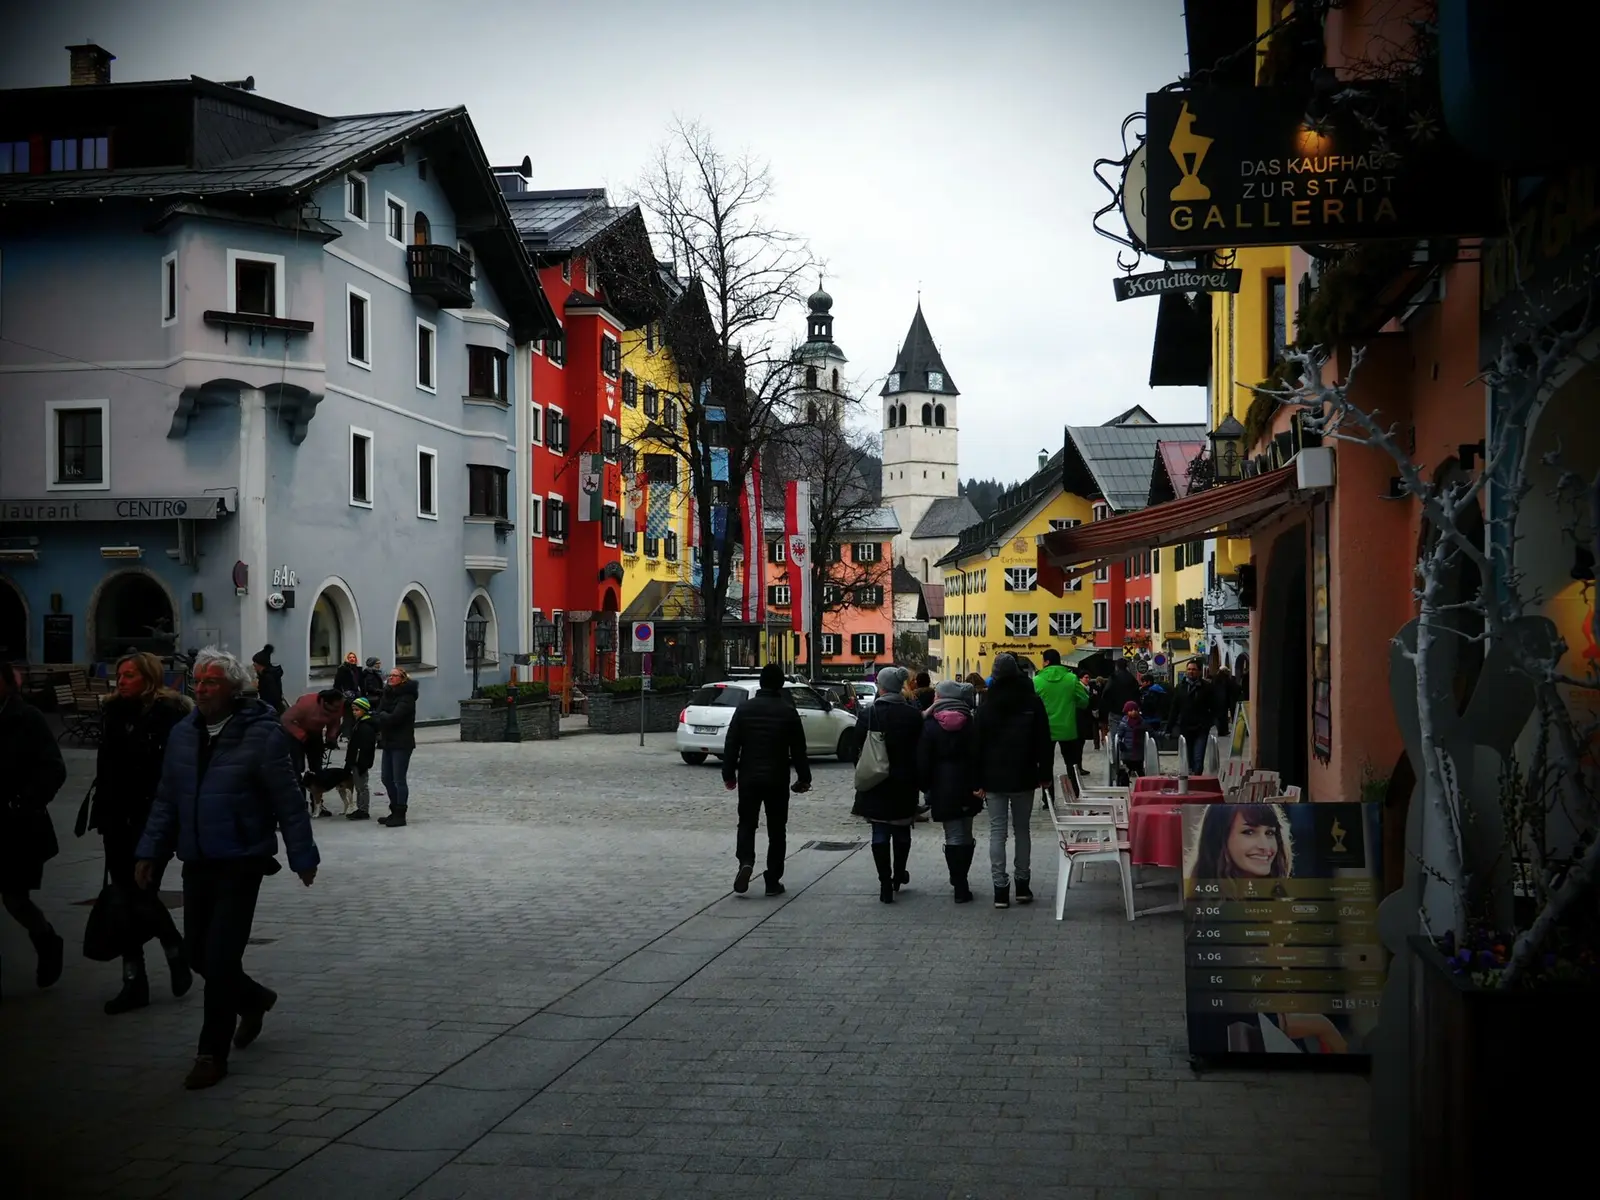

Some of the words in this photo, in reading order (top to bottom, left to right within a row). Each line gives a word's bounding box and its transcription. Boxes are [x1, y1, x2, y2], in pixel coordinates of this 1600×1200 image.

[1240, 159, 1281, 177] DAS
[1242, 181, 1296, 199] ZUR
[1306, 176, 1397, 196] STADT
[1170, 196, 1399, 232] GALLERIA
[1124, 271, 1229, 297] Konditorei
[116, 499, 187, 519] CENTRO
[273, 564, 296, 586] BAR
[1194, 884, 1204, 893] 4.
[1205, 884, 1219, 893] OG
[1195, 906, 1205, 915] 3.
[1206, 906, 1220, 916] OG
[1196, 929, 1205, 938] 2.
[1206, 929, 1221, 938] OG
[1197, 952, 1206, 961] 1.
[1207, 952, 1222, 961] OG
[1210, 975, 1223, 984] EG
[1212, 998, 1224, 1007] U1
